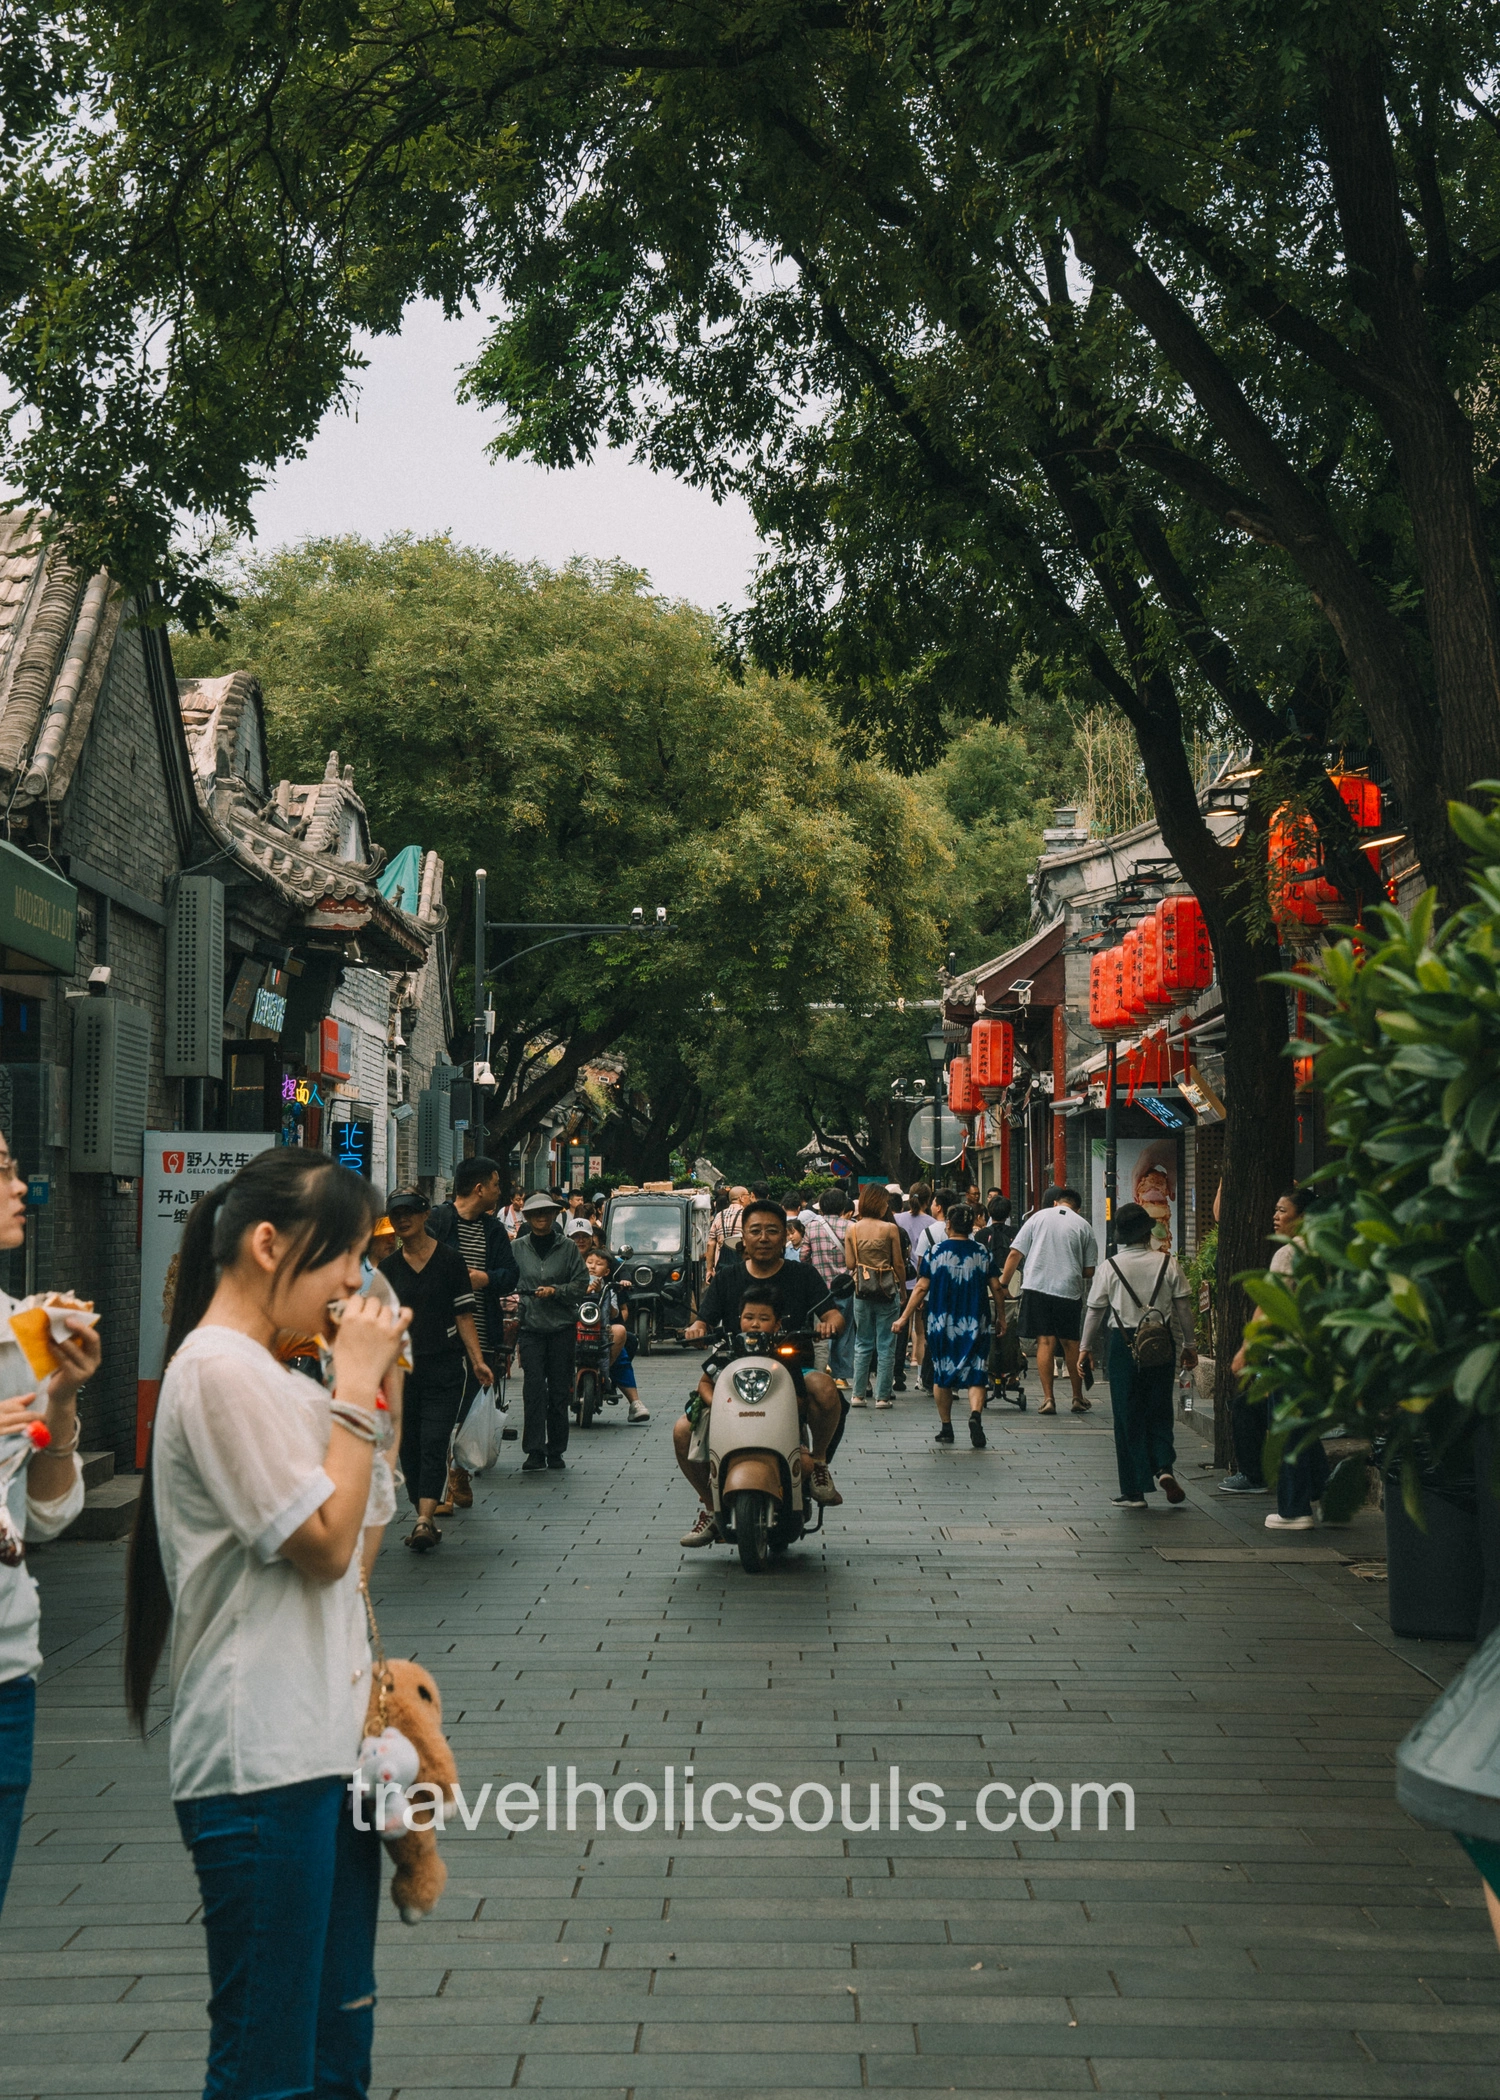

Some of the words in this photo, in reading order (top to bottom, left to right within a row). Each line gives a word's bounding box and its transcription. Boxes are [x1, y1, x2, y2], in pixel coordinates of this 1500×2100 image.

[14, 885, 50, 931] MODERN
[51, 904, 73, 942] LADY
[282, 1074, 324, 1106] 捏面人
[187, 1152, 249, 1167] 野人先生
